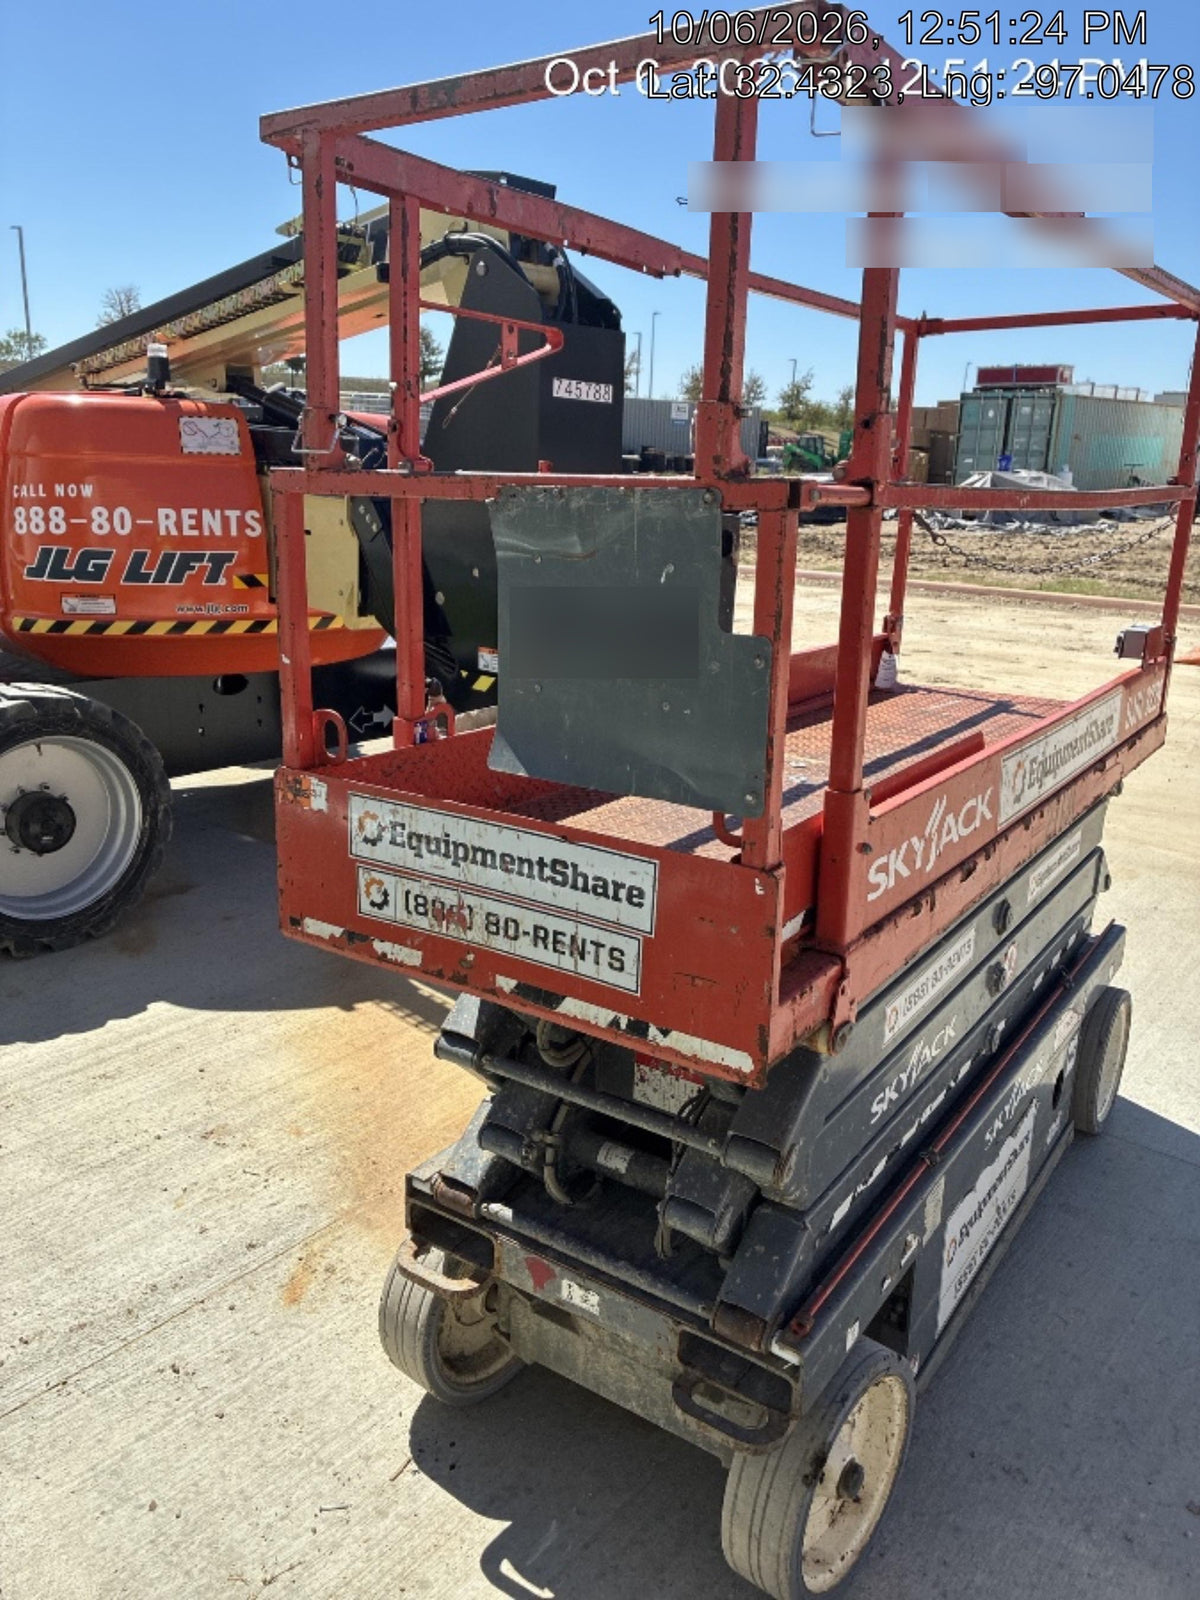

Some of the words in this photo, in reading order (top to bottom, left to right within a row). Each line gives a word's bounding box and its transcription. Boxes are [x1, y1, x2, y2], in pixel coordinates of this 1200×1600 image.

[13, 483, 47, 498] CALL
[54, 483, 93, 498] NOW
[13, 506, 262, 538] 888-80-RENTS
[24, 545, 116, 584] JLG
[120, 549, 238, 586] LIFT
[175, 603, 250, 616] www.jlg.com
[866, 785, 995, 902] SKYJACK
[389, 820, 646, 909] EquipmentShare
[404, 889, 474, 932] (8)
[484, 910, 626, 973] 80-RENTS
